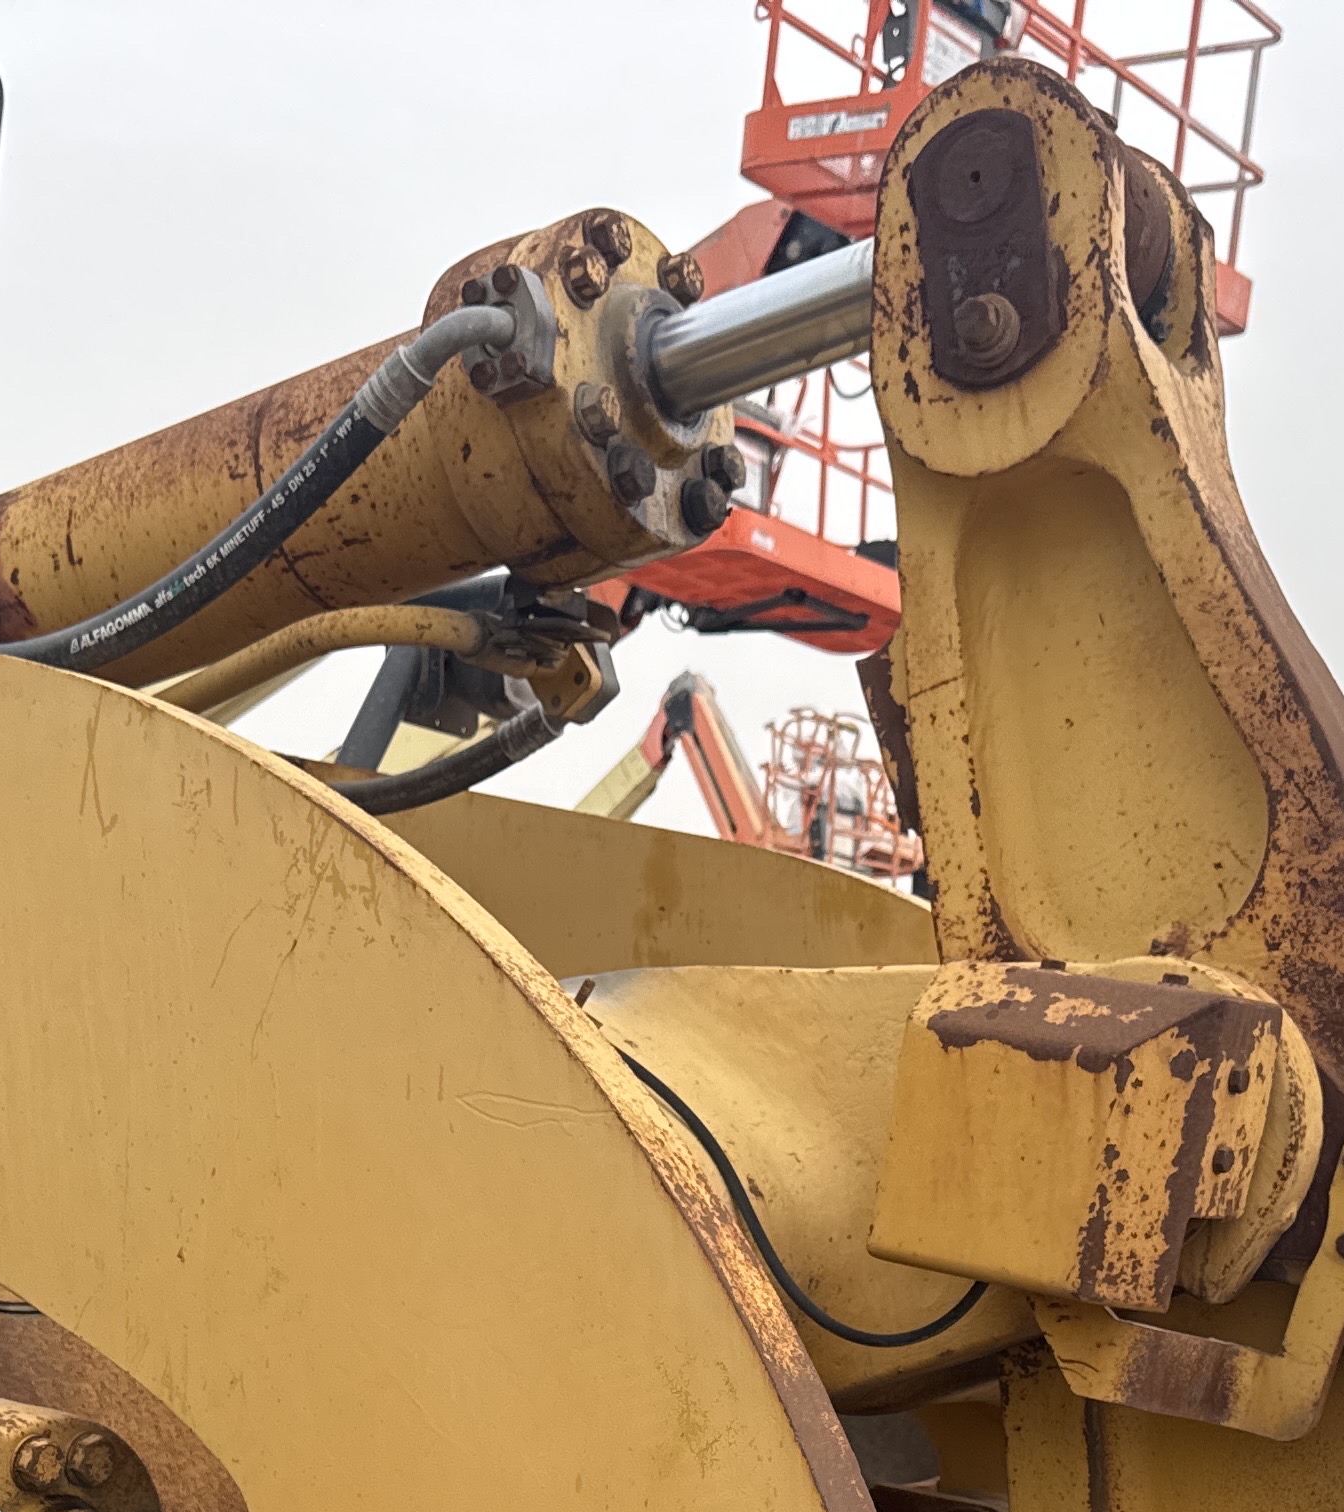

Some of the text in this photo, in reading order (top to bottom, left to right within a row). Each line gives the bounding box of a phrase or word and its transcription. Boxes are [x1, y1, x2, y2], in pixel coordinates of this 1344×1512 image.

[81, 602, 153, 650] ALFAGOMMA
[219, 508, 266, 559] MINETUFF
[271, 493, 286, 510] 4S
[287, 473, 305, 493] DN
[302, 459, 317, 478] 25
[335, 418, 353, 440] WP
